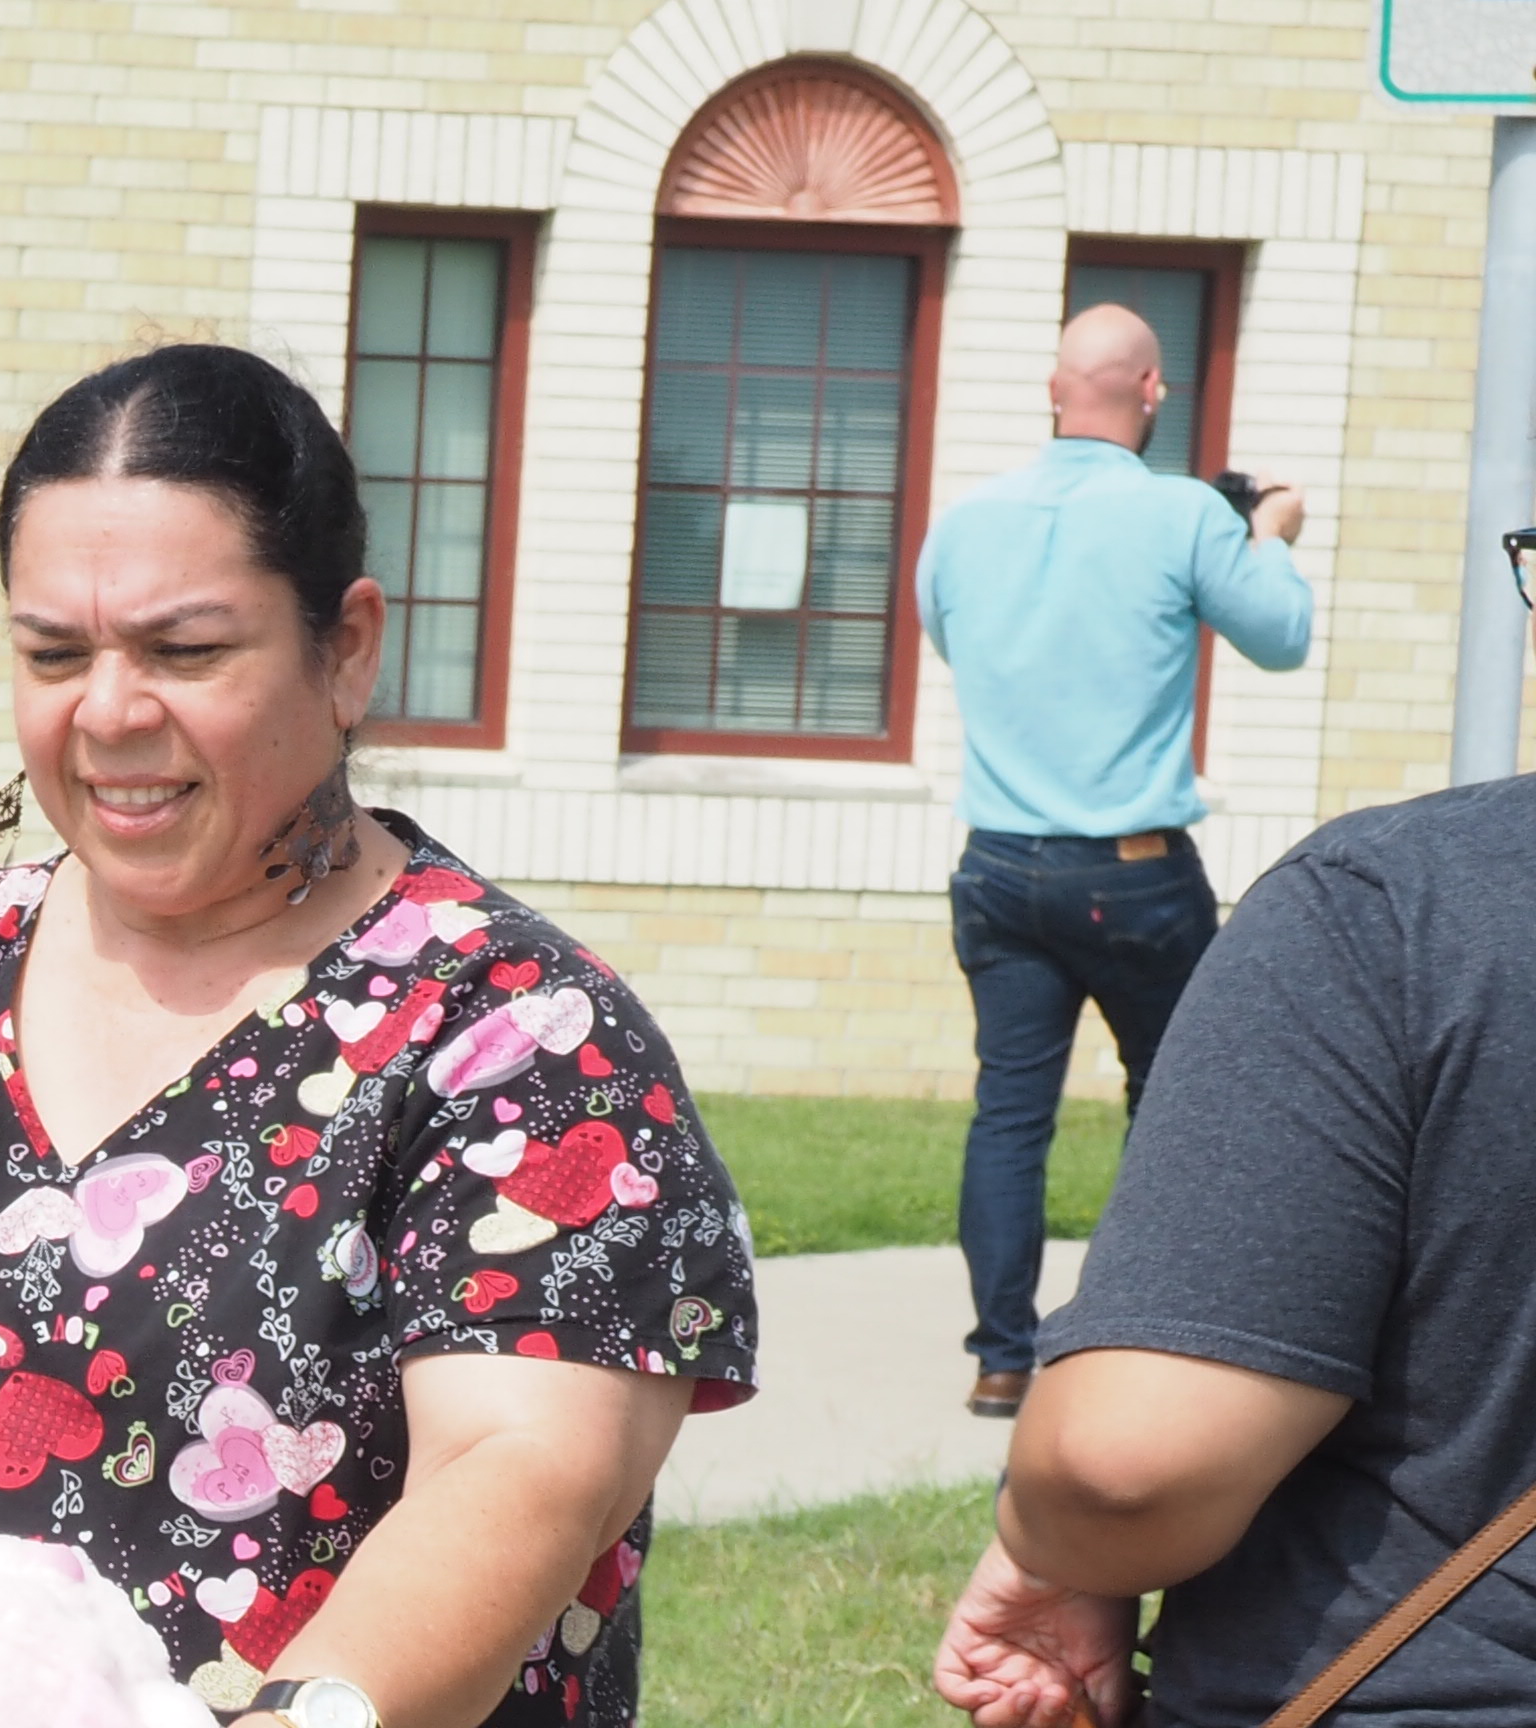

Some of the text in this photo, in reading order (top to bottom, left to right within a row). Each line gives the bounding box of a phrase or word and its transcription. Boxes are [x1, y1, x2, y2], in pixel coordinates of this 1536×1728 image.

[268, 990, 337, 1029] LOVE
[32, 1313, 100, 1351] LOVE
[133, 1562, 203, 1612] LOVE
